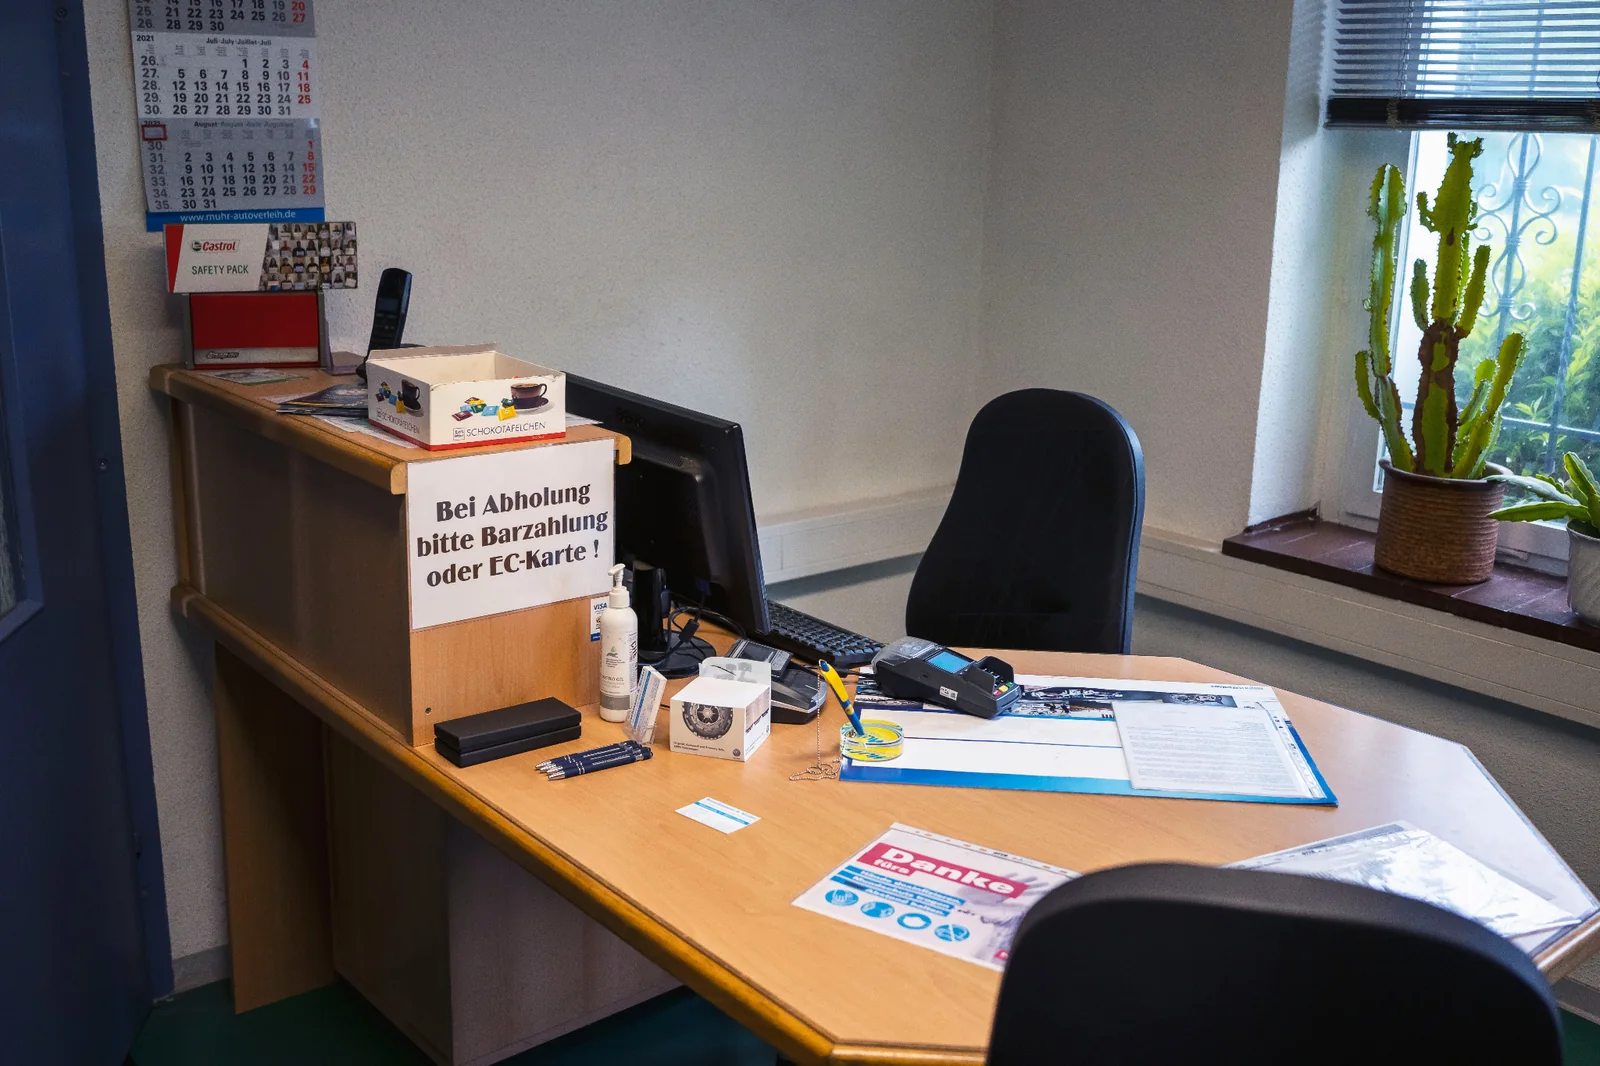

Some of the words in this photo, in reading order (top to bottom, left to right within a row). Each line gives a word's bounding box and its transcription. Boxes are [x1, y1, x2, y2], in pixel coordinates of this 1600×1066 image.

[252, 0, 264, 9] 18
[273, 0, 285, 10] 19
[292, 1, 305, 11] 20
[166, 7, 179, 17] 21
[187, 9, 202, 18] 22
[209, 9, 223, 19] 23
[231, 10, 244, 20] 24
[252, 11, 265, 21] 25
[272, 12, 286, 22] 26
[293, 12, 306, 22] 27
[167, 20, 181, 29] 28
[188, 20, 203, 30] 29
[210, 21, 224, 31] 30
[242, 59, 247, 68] 1
[262, 59, 269, 68] 2
[283, 60, 289, 69] 3
[303, 60, 309, 69] 4
[142, 68, 160, 78] 27.
[178, 69, 184, 78] 5
[200, 70, 206, 79] 6
[221, 70, 228, 79] 7
[242, 71, 249, 80] 8
[263, 71, 269, 80] 9
[278, 71, 289, 81] 10
[298, 72, 308, 80] 11
[143, 81, 160, 90] 28.
[173, 81, 186, 90] 12
[194, 82, 207, 91] 13
[216, 82, 228, 91] 14
[237, 83, 249, 92] 15
[258, 83, 270, 92] 16
[278, 83, 290, 92] 17
[298, 83, 310, 92] 18
[144, 93, 161, 102] 29.
[173, 93, 186, 102] 19
[194, 94, 208, 103] 20
[216, 94, 228, 103] 21
[236, 94, 250, 103] 22
[257, 94, 271, 104] 23
[278, 94, 291, 104] 24
[298, 95, 311, 104] 25
[145, 105, 162, 115] 30.
[173, 105, 187, 115] 26
[195, 105, 208, 115] 27
[216, 106, 230, 115] 28
[237, 106, 251, 115] 29
[258, 106, 271, 115] 30
[278, 106, 291, 115] 31
[308, 141, 313, 149] 1
[185, 153, 191, 162] 2
[206, 153, 212, 162] 3
[226, 153, 233, 162] 4
[247, 153, 254, 162] 5
[268, 152, 274, 161] 6
[288, 152, 294, 161] 7
[308, 152, 314, 161] 8
[186, 164, 192, 174] 9
[201, 165, 213, 174] 10
[222, 164, 233, 173] 11
[242, 164, 254, 173] 12
[263, 164, 275, 173] 13
[283, 164, 295, 173] 14
[303, 164, 314, 172] 15
[181, 176, 193, 186] 16
[202, 176, 214, 185] 17
[223, 176, 235, 185] 18
[244, 176, 256, 185] 19
[263, 175, 276, 184] 20
[283, 175, 295, 184] 21
[303, 174, 315, 183] 22
[181, 188, 195, 197] 23
[202, 188, 216, 197] 24
[223, 188, 236, 197] 25
[243, 187, 256, 196] 26
[264, 187, 276, 196] 27
[283, 186, 296, 195] 28
[303, 186, 316, 194] 29
[183, 200, 196, 209] 30
[204, 199, 217, 208] 31
[180, 210, 296, 222] www.muhr-autoverleih.de
[203, 242, 236, 251] Castrol
[192, 265, 225, 275] SAFETY
[227, 265, 248, 274] PACK
[467, 421, 546, 437] SCHOKOTAFELCHEN
[436, 496, 475, 522] Bei
[482, 484, 590, 515] Abholung
[417, 532, 474, 557] bitte
[482, 511, 608, 547] Barzahlung
[427, 562, 483, 587] oder
[490, 544, 587, 576] EC-Karte
[881, 848, 1014, 894] Danke
